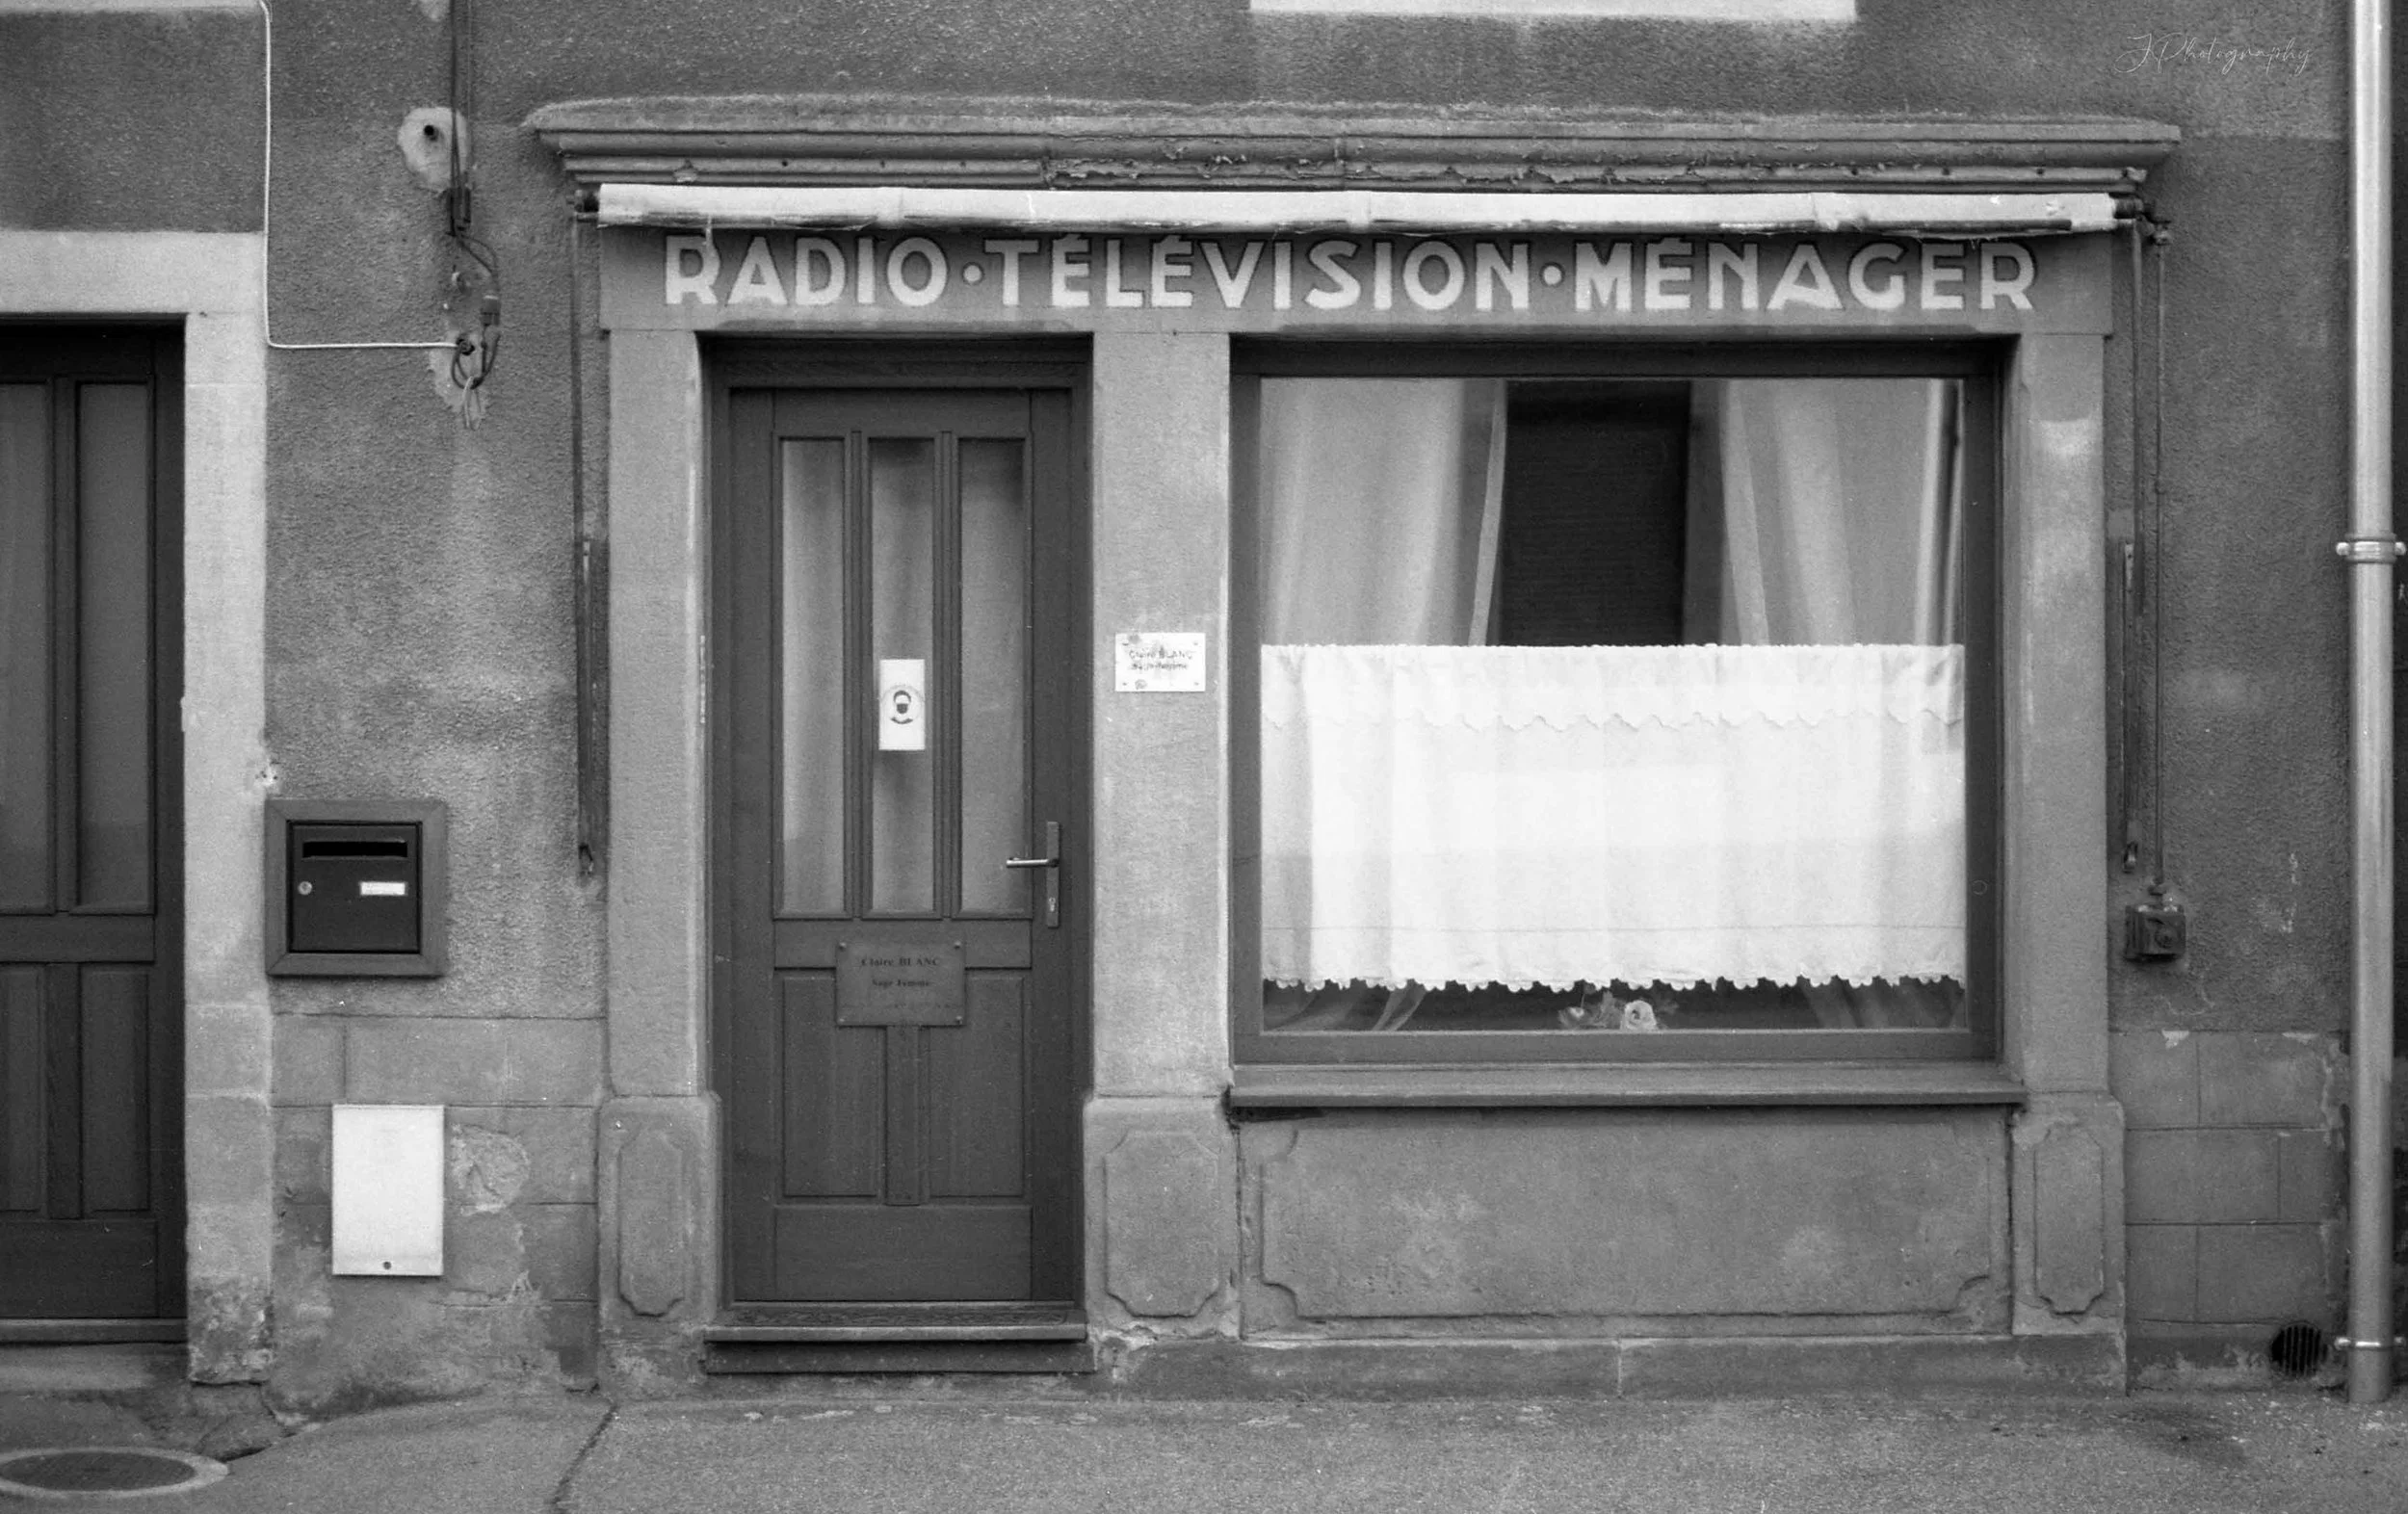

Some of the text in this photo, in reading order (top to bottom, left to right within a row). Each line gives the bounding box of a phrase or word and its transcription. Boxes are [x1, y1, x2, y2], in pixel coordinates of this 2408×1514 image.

[664, 234, 2035, 311] RADIO TÉLÉVISION MÉNAGER
